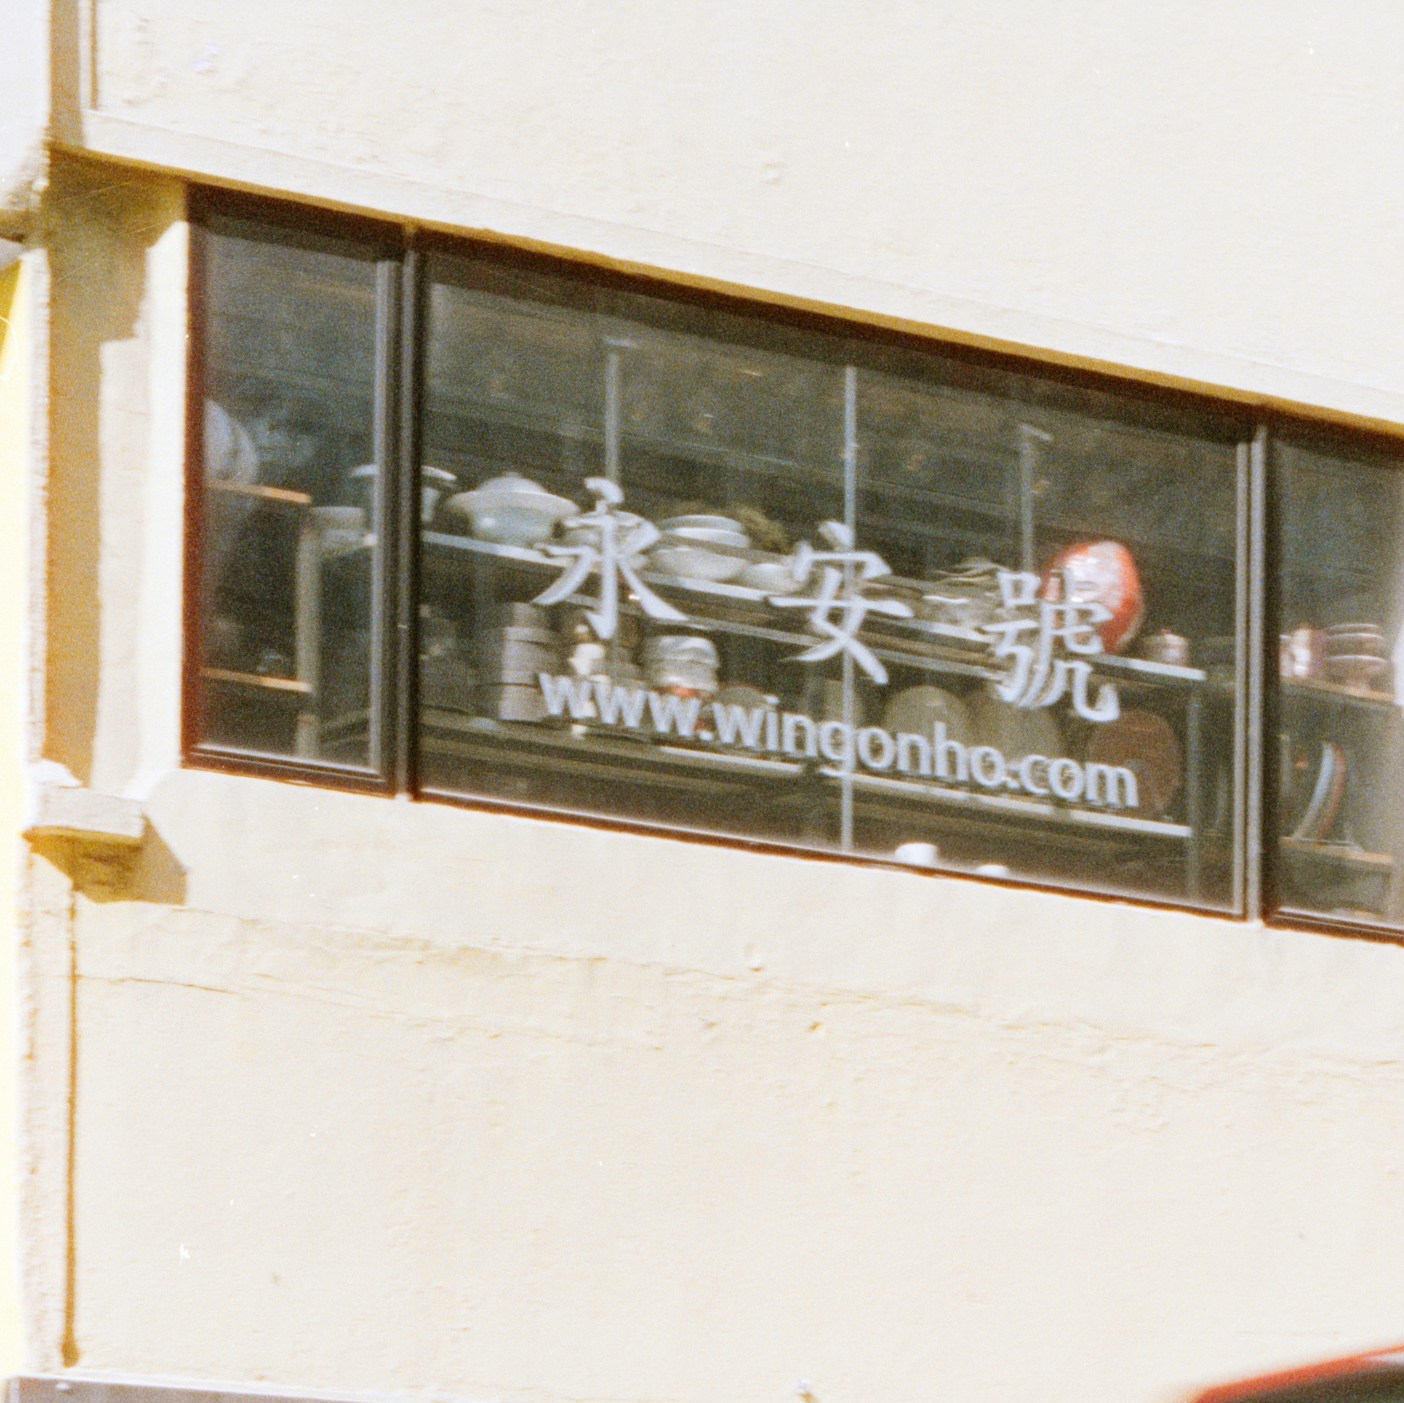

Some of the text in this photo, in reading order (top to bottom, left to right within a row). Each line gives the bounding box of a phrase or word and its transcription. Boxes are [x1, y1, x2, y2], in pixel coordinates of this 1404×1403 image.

[531, 476, 1121, 722] 永安號
[538, 671, 1139, 808] www.wingonho.com
